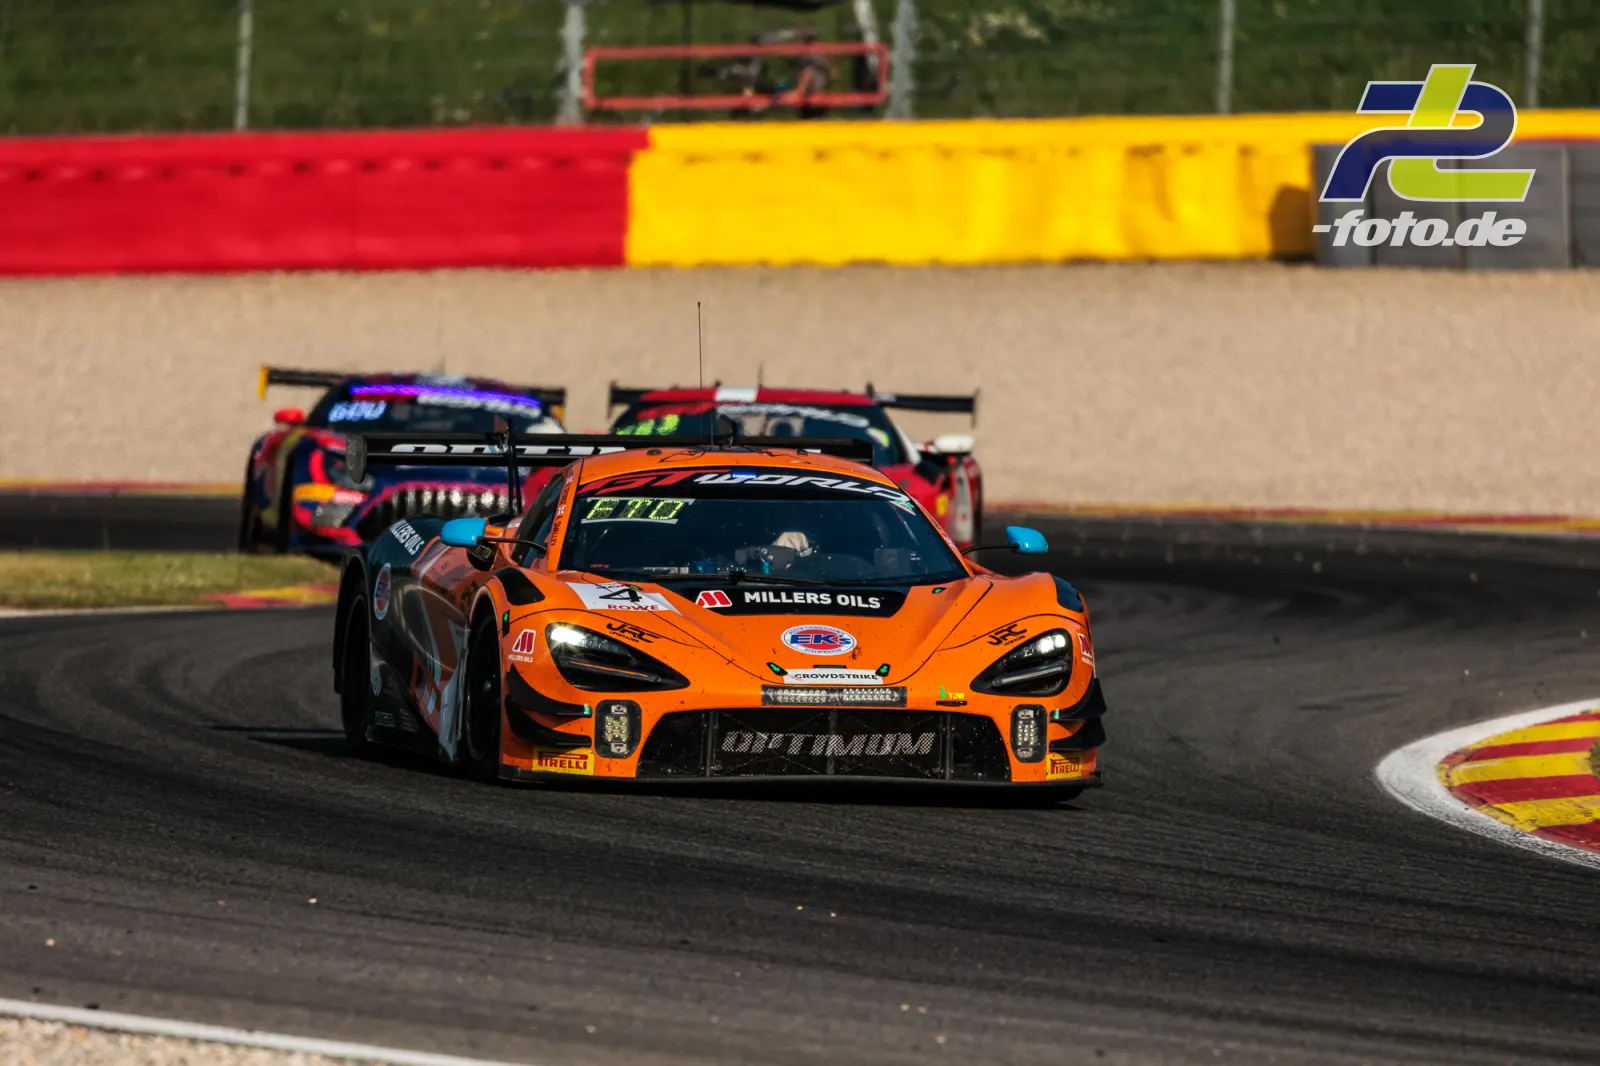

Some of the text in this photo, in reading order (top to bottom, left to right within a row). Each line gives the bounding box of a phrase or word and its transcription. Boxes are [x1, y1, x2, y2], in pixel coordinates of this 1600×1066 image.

[694, 473, 910, 502] WORLD
[586, 498, 684, 520] FTO
[598, 588, 643, 603] 4
[744, 591, 881, 609] MILLERS OILS
[606, 622, 661, 643] JRC
[987, 623, 1028, 646] JRC
[948, 691, 965, 700] TOW
[721, 731, 936, 756] OPTIMUM
[537, 751, 588, 770] PIRELLI
[1050, 757, 1081, 775] PIRELLI
